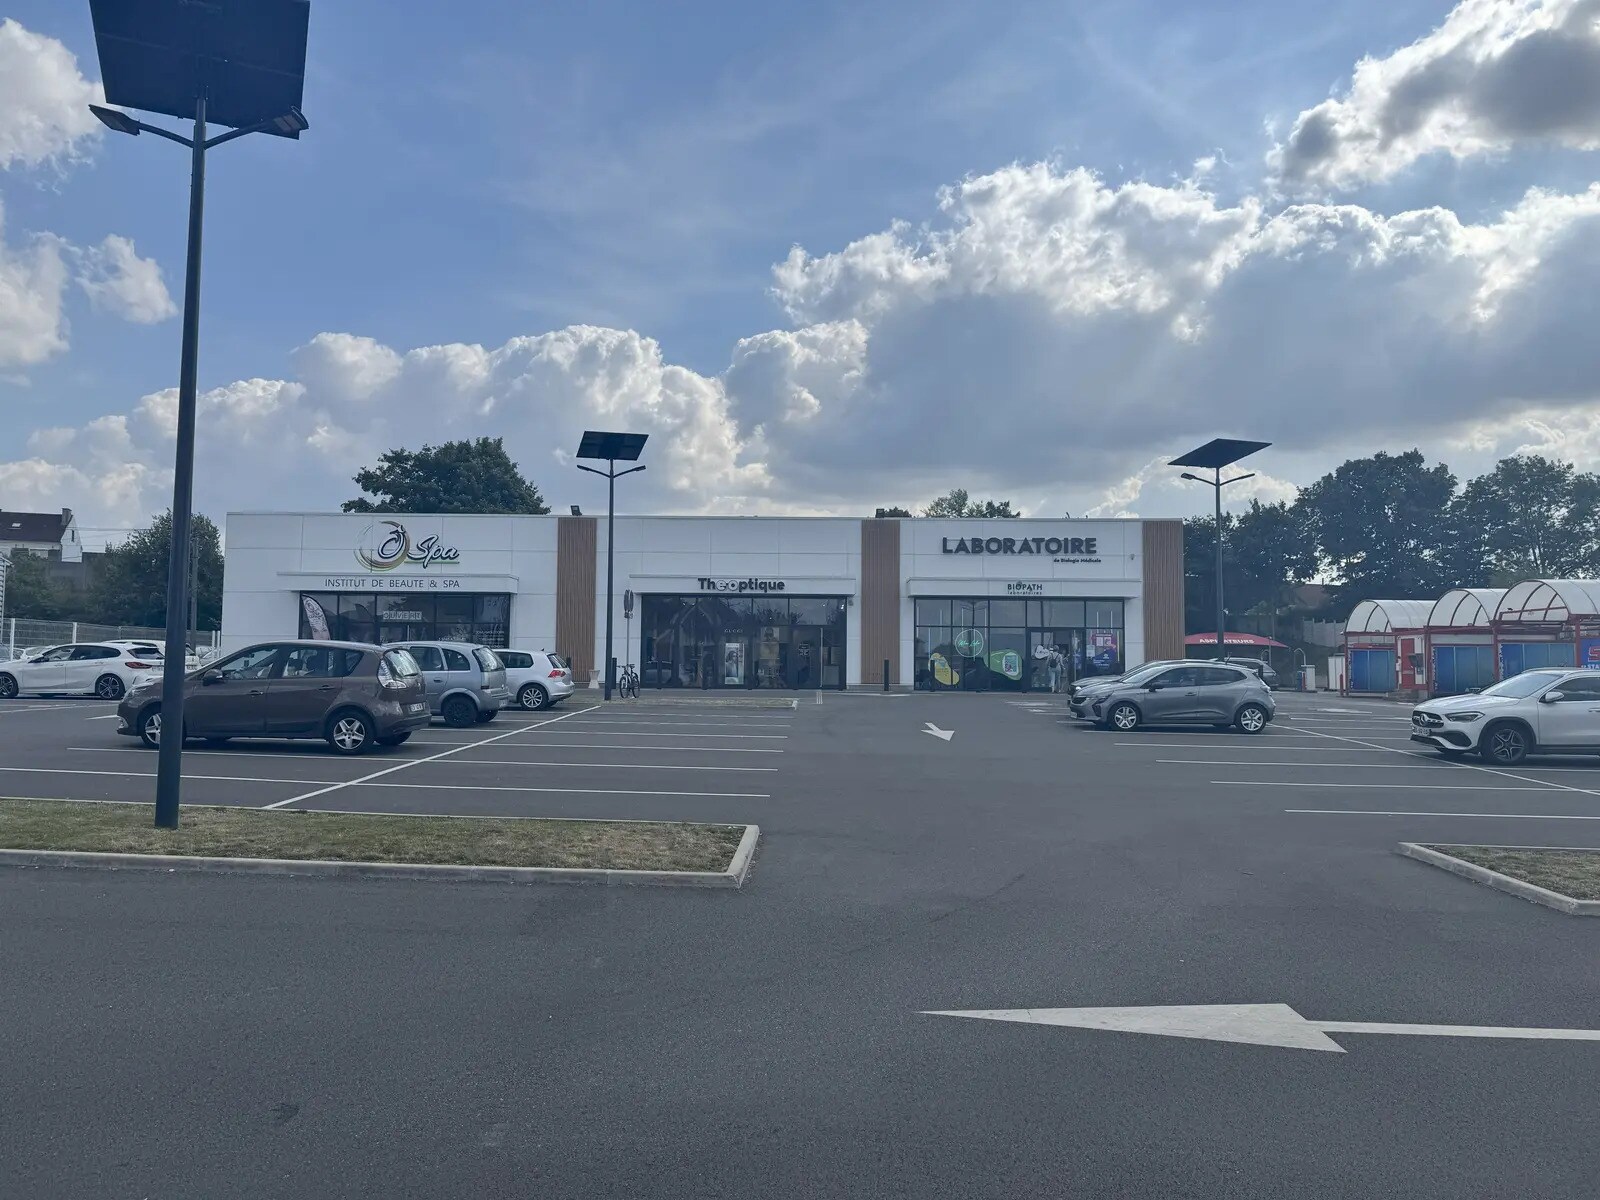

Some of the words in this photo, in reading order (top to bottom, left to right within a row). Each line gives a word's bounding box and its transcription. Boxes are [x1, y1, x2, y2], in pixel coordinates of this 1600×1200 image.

[942, 537, 1097, 555] LABORATOIRE
[407, 533, 460, 569] Spa
[323, 579, 366, 588] INSTITUT
[371, 579, 384, 588] DE
[389, 579, 424, 588] BEAUTE
[429, 579, 438, 588] &
[443, 579, 460, 588] SPA
[1007, 583, 1043, 591] BIOPATH
[383, 611, 422, 620] OUVERT
